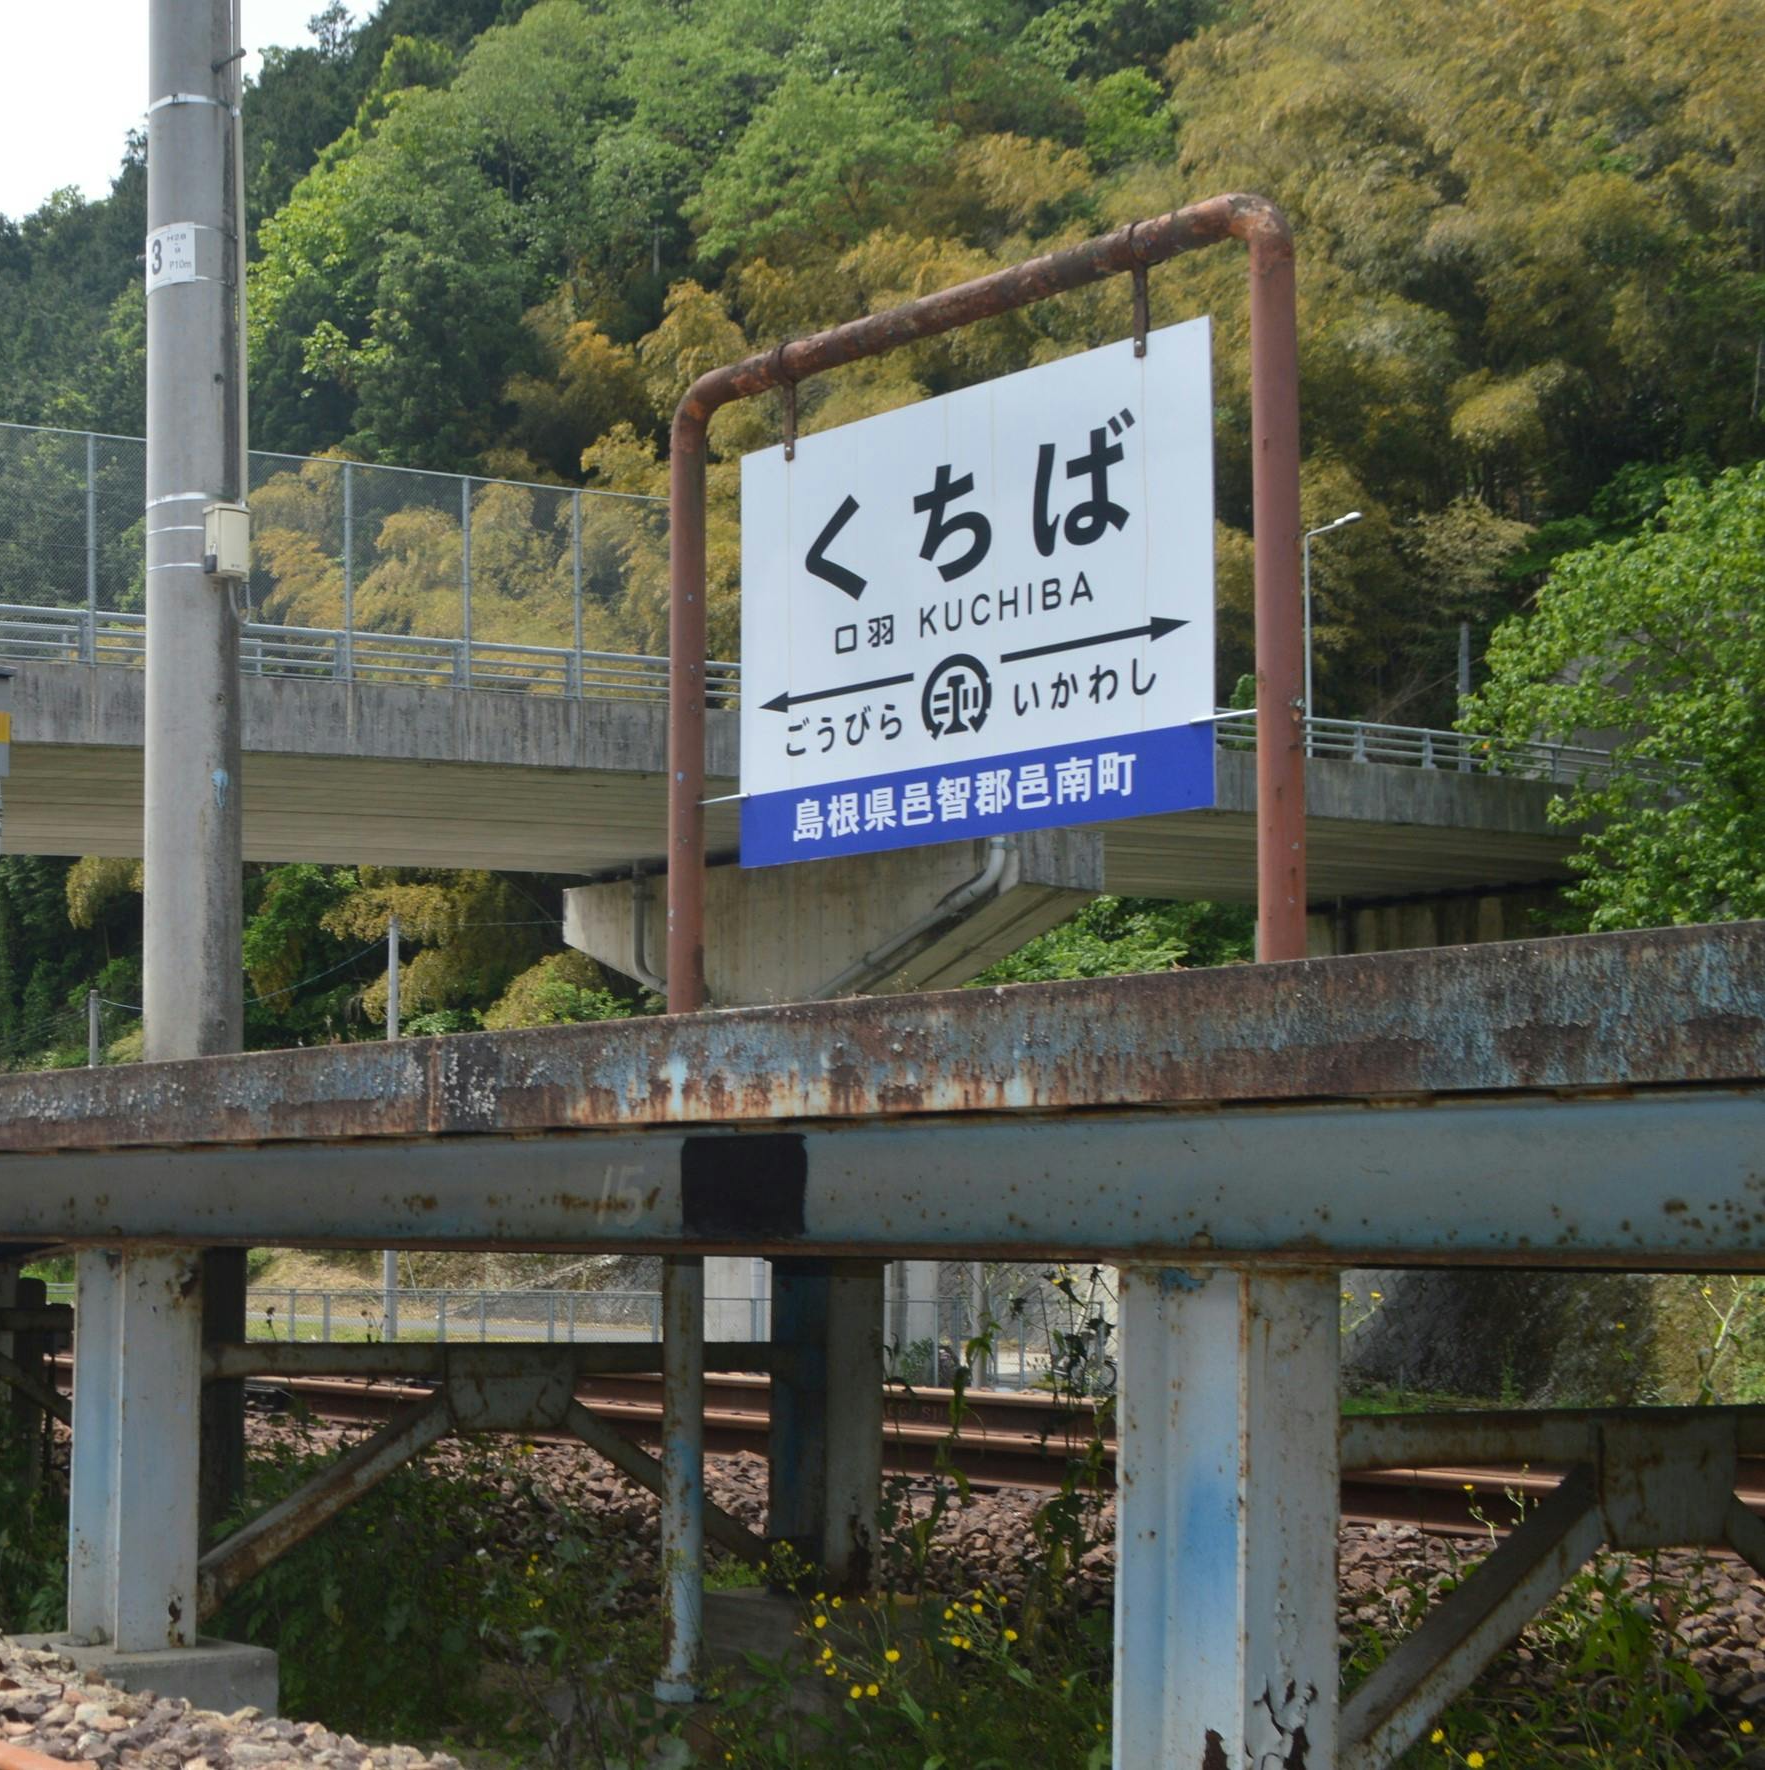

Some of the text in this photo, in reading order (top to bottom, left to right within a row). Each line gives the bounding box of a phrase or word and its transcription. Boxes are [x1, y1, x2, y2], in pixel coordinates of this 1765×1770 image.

[152, 238, 163, 275] 3
[805, 408, 1136, 601] くちば
[835, 614, 894, 654] 口羽
[919, 571, 1094, 638] KUCHIBA
[1014, 657, 1157, 717] いかわし
[786, 703, 903, 757] ごうびら
[792, 751, 1137, 843] 島根県邑智郡邑南町
